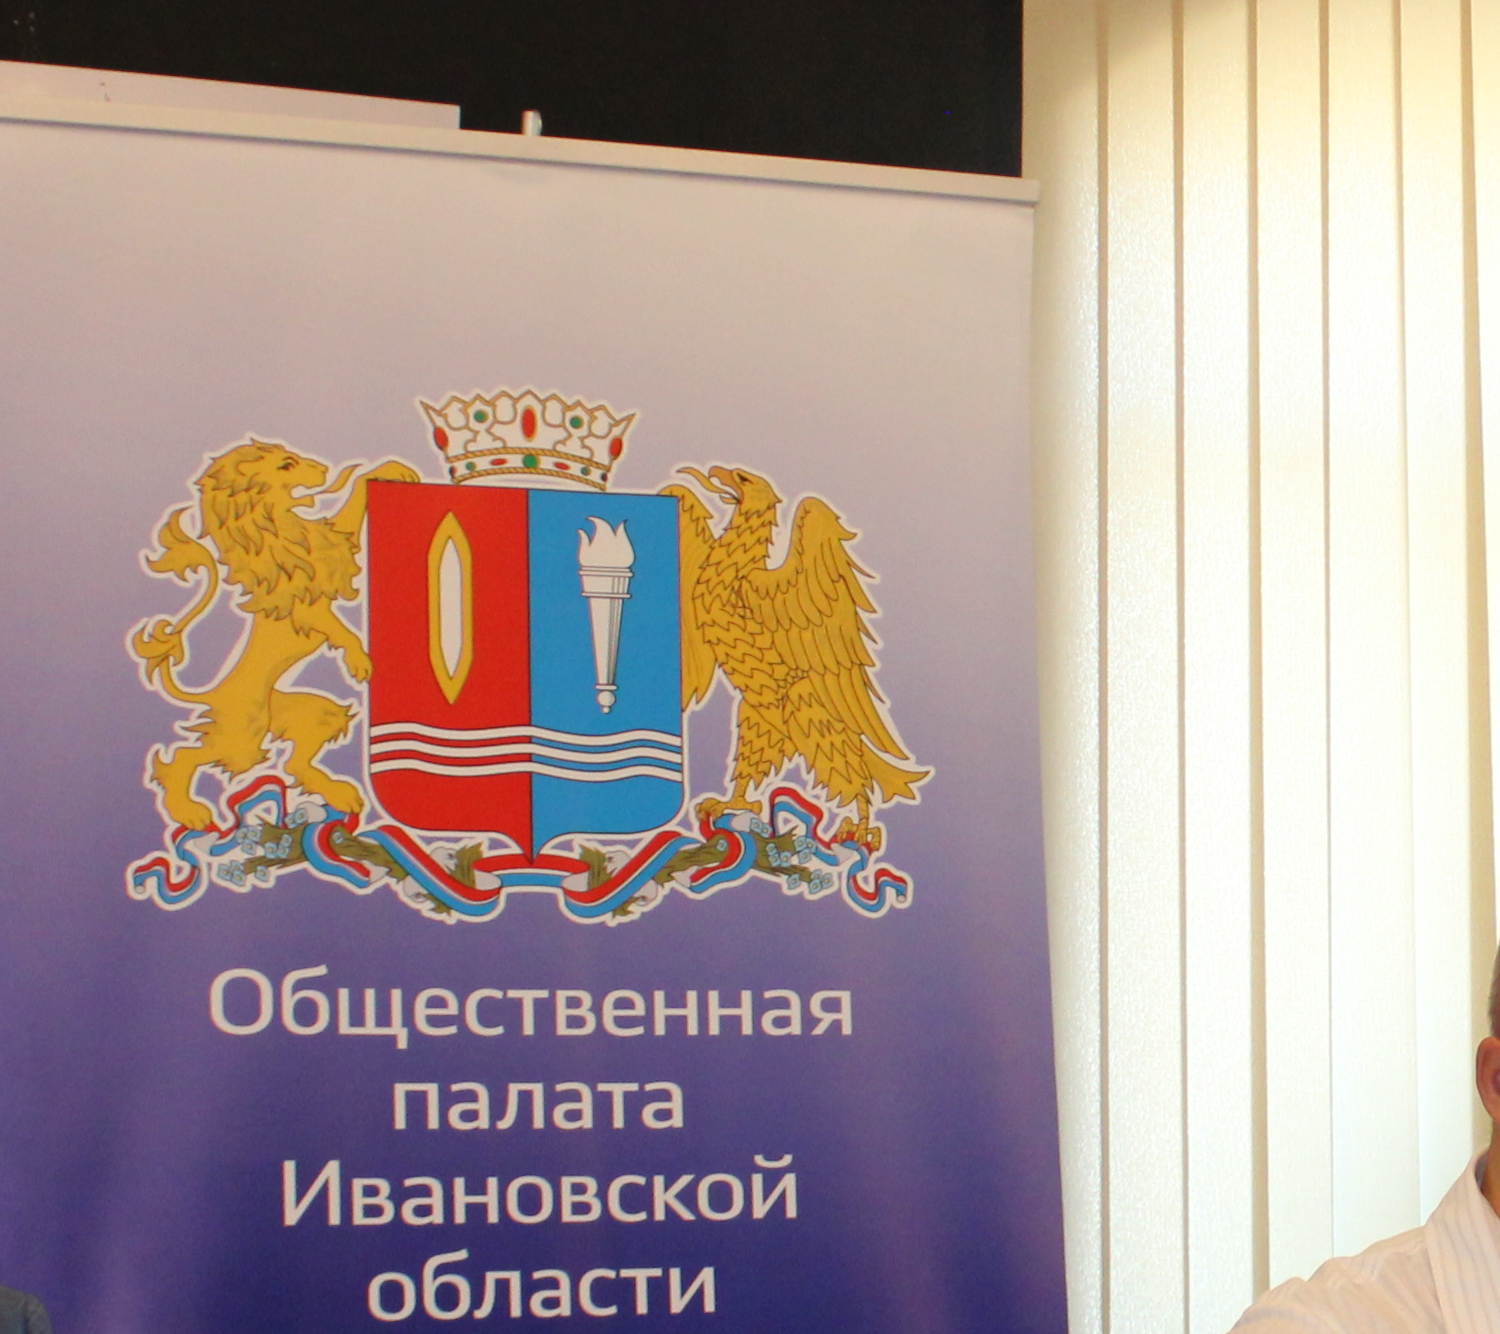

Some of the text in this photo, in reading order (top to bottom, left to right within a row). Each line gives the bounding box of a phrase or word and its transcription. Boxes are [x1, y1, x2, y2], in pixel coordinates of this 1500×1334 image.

[208, 964, 854, 1049] Общественная
[392, 1079, 686, 1130] палата
[281, 1154, 799, 1228] Ивановской
[367, 1249, 718, 1323] области
